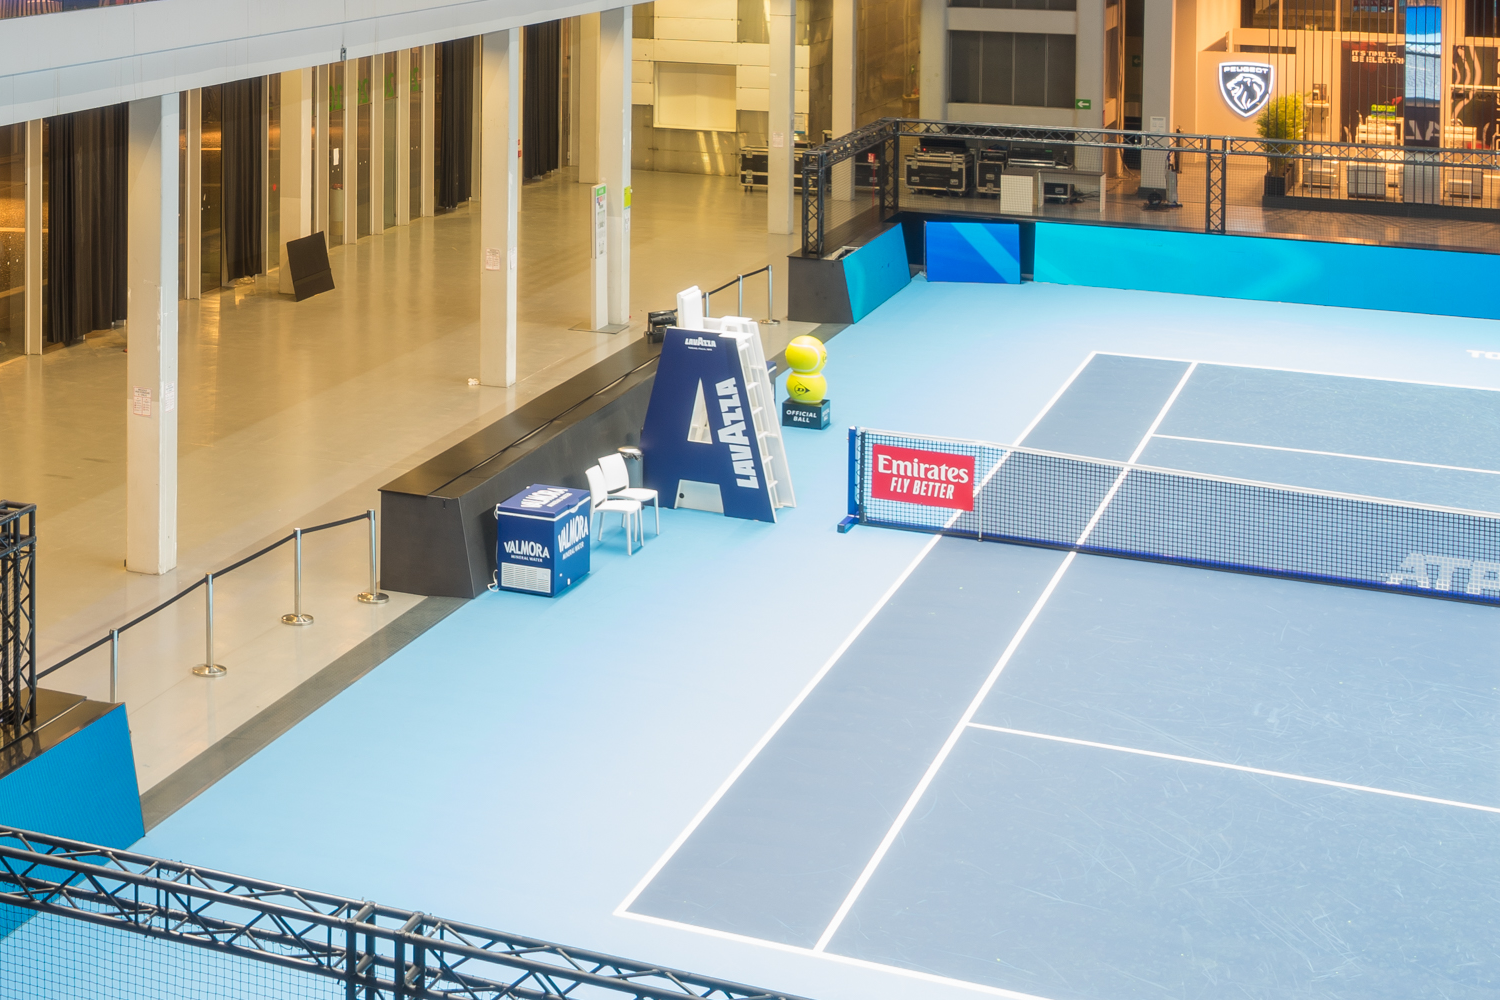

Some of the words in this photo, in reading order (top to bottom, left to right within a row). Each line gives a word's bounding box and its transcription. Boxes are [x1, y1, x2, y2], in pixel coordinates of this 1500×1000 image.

[1366, 56, 1405, 64] ELECTRI
[1224, 66, 1269, 74] PEUGEOT
[685, 337, 716, 348] LAVAZZA
[786, 410, 817, 418] OFFICIAL
[715, 377, 759, 489] LAVAZZA
[878, 454, 969, 483] Emirates
[890, 477, 910, 493] FLY
[912, 480, 955, 500] BETTER
[558, 515, 588, 553] VALMORA
[504, 540, 550, 559] VALMORA
